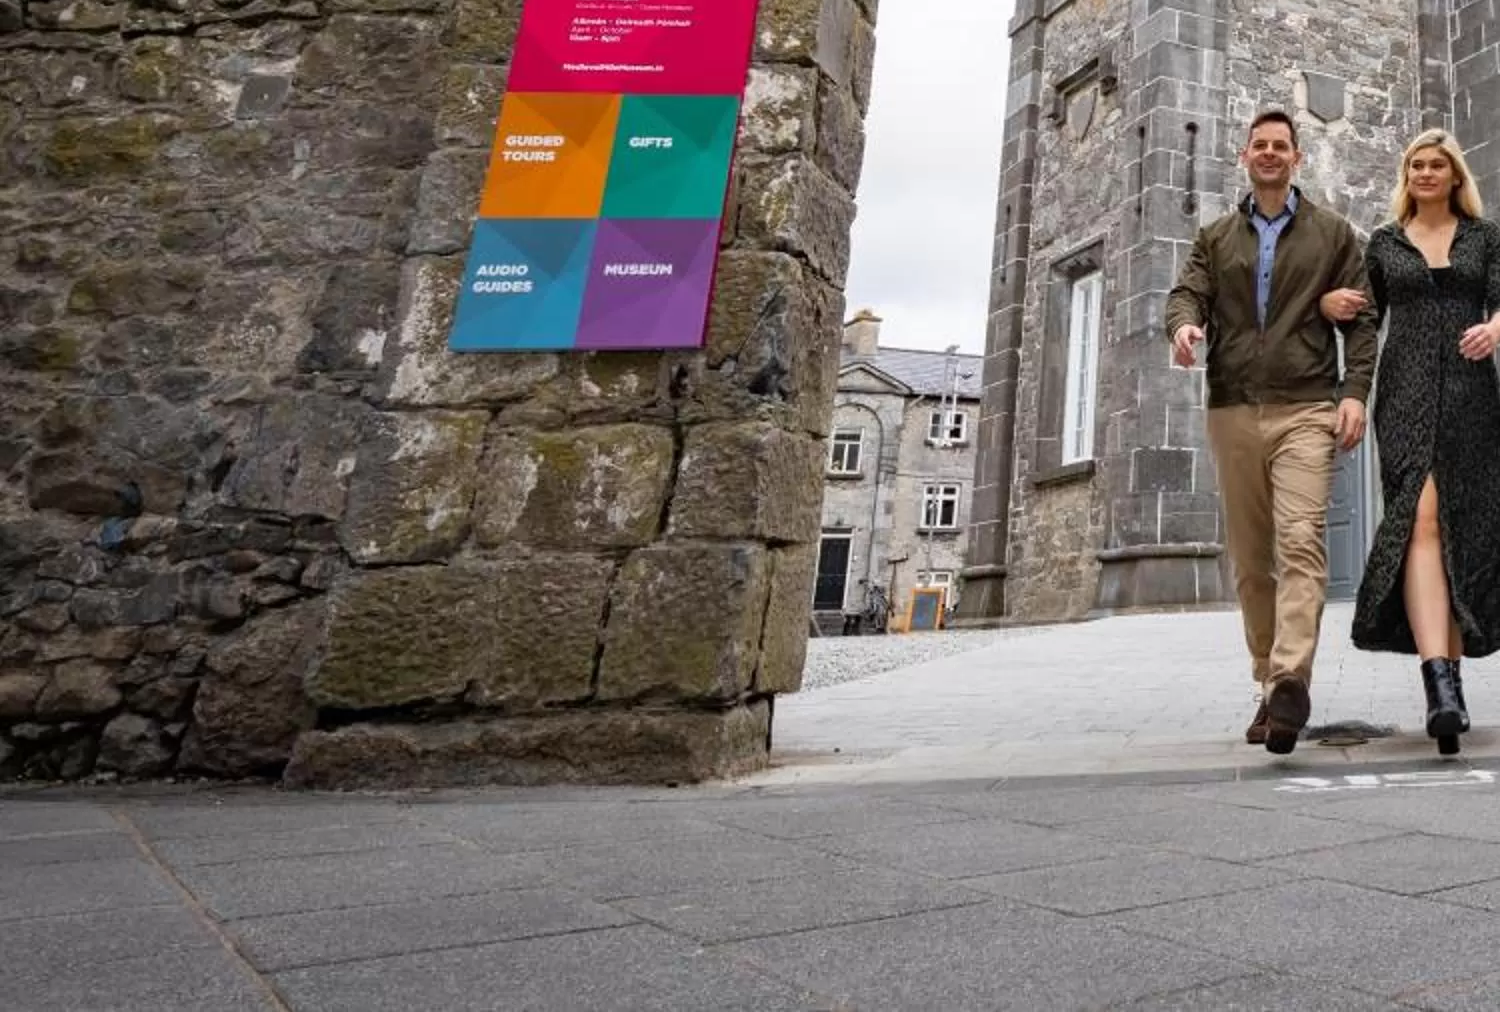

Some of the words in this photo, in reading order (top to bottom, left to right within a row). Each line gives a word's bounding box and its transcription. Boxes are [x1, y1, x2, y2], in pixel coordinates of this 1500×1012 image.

[505, 135, 566, 148] GUIDED
[629, 136, 674, 148] GIFTS
[502, 150, 556, 162] TOURS
[476, 264, 529, 277] AUDIO
[604, 263, 674, 276] MUSEUM
[472, 280, 533, 293] GUIDES
